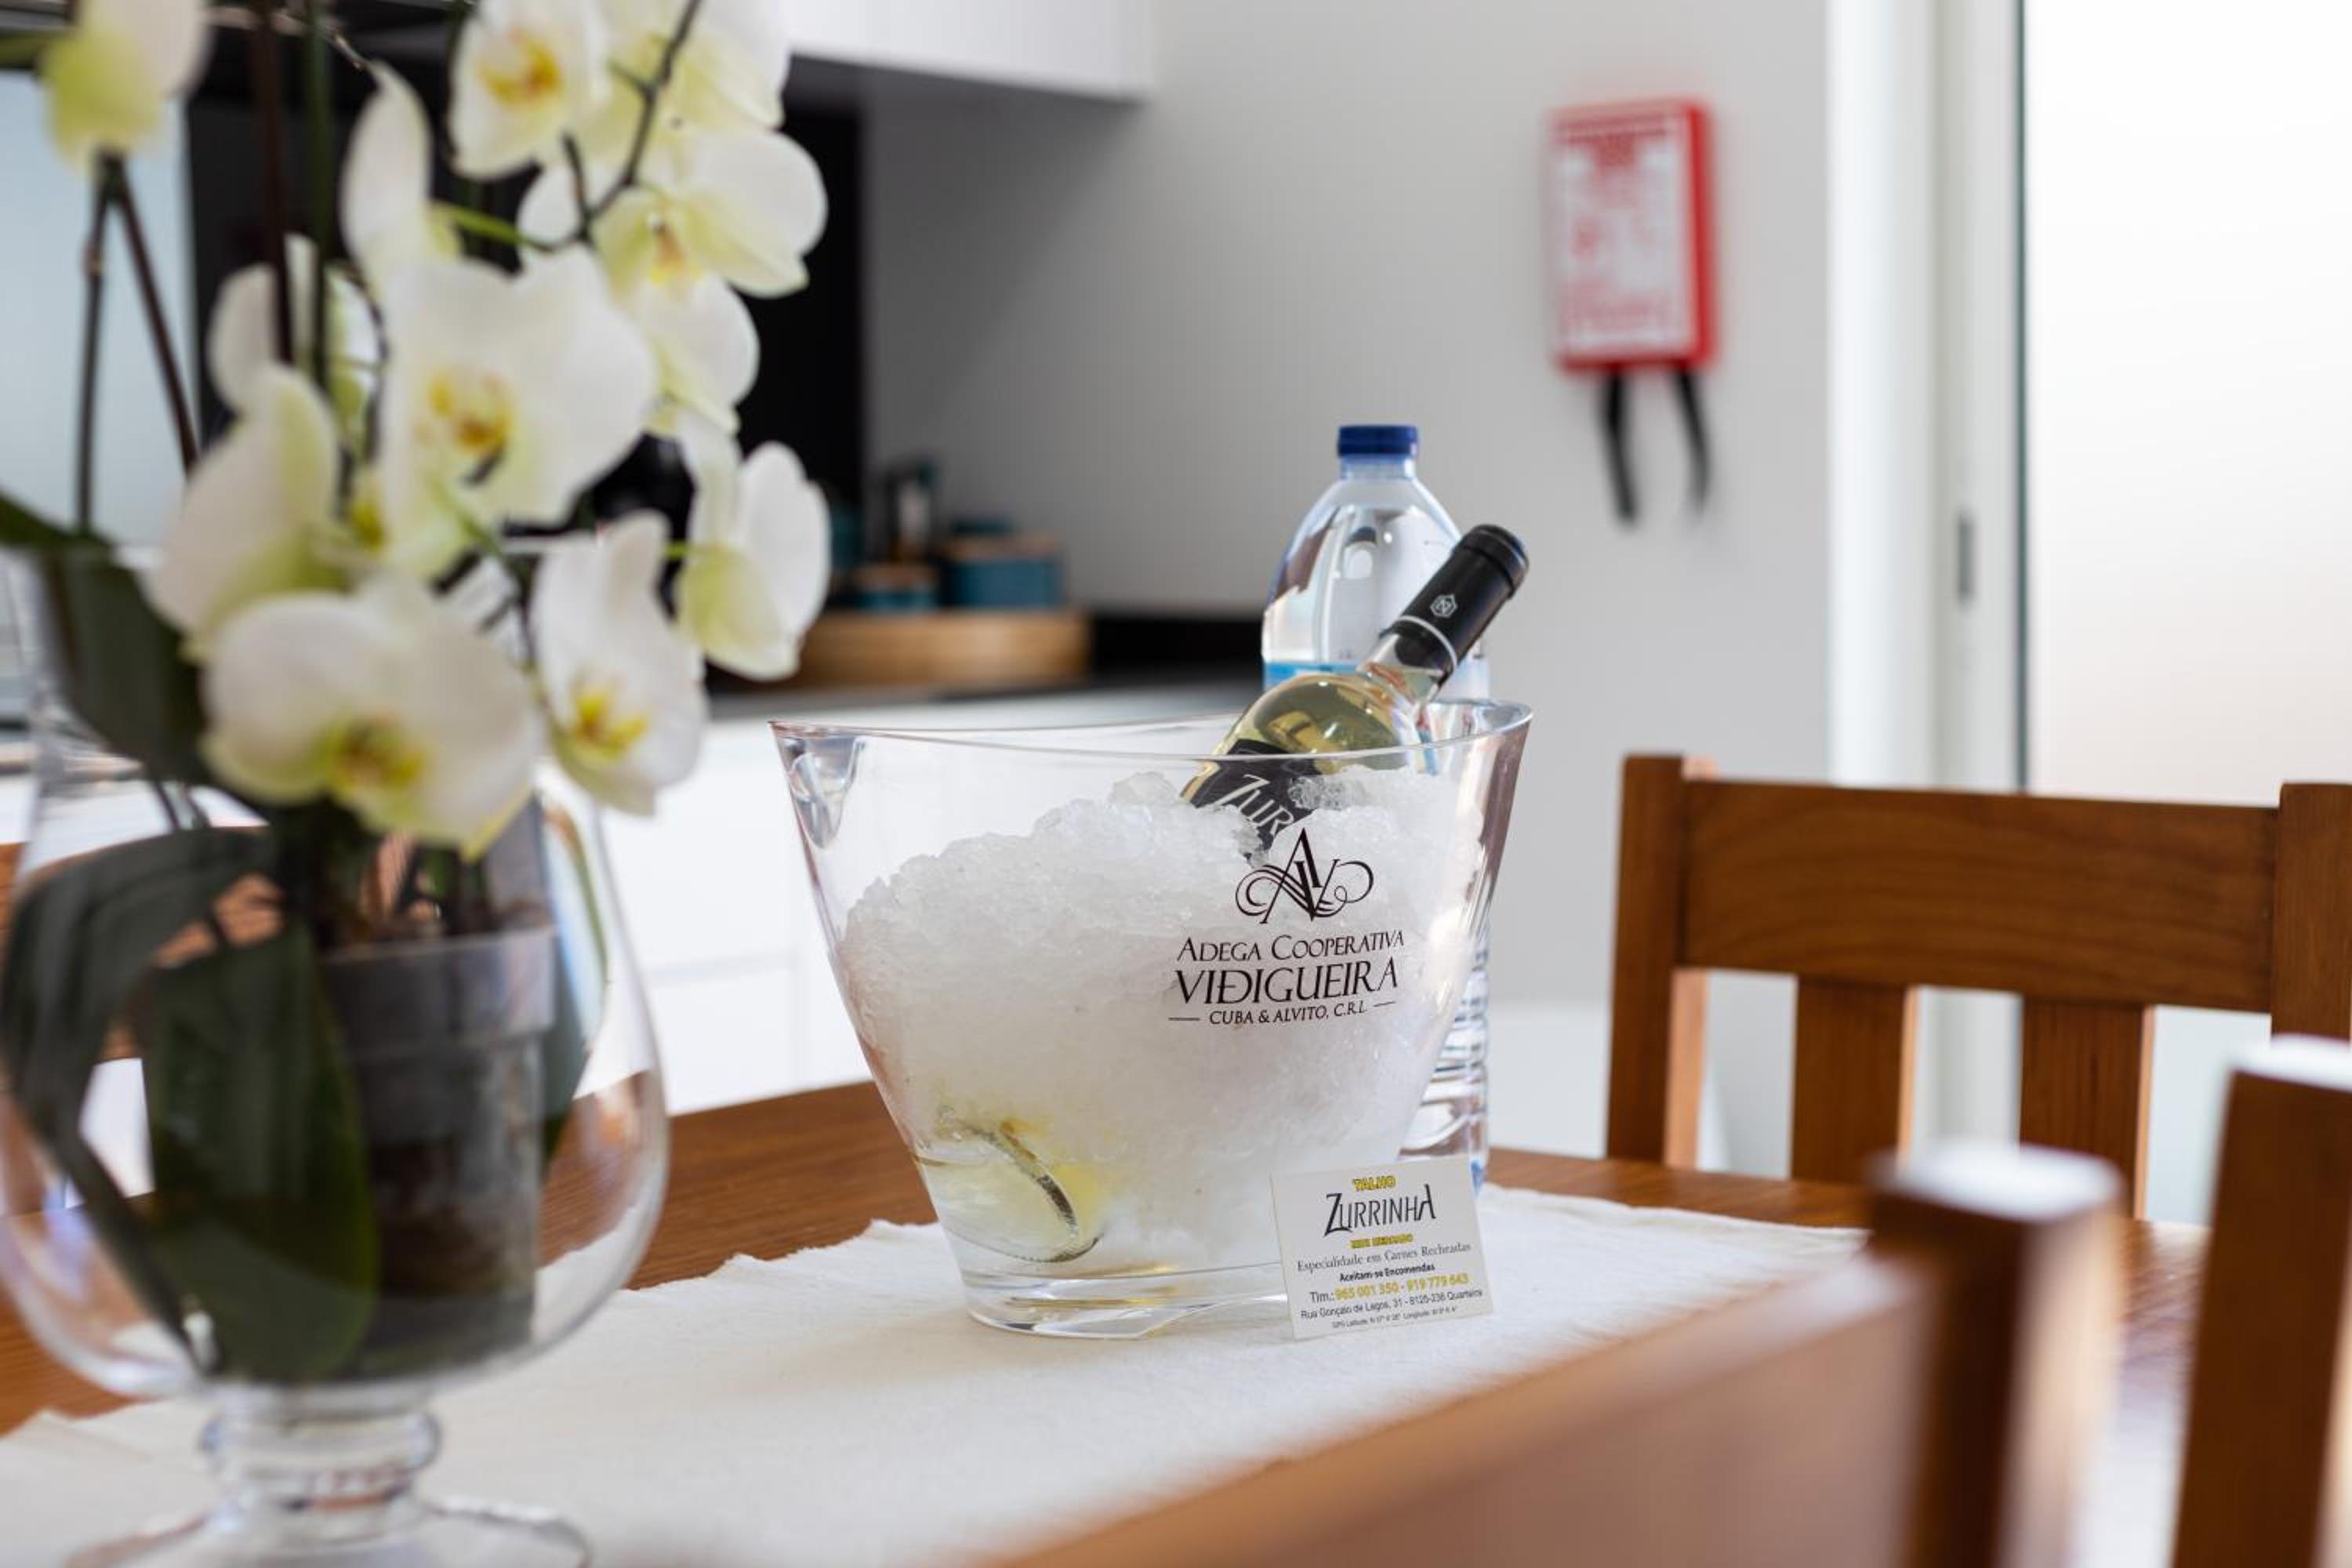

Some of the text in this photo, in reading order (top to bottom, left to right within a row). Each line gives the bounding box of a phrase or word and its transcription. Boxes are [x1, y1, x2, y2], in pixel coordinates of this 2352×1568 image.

[1177, 930, 1405, 962] ADEGA COOPERATIVA
[1175, 956, 1398, 1004] VIDIGUEIRA
[1210, 1011, 1254, 1025] CUBA
[1258, 1010, 1270, 1023] &
[1274, 1005, 1330, 1023] ALVITO,
[1352, 1175, 1396, 1191] TALHO
[1324, 1184, 1436, 1237] ZURRINHA
[1298, 1255, 1363, 1275] Especialidade
[1385, 1263, 1435, 1276] Encomendas
[1301, 1310, 1317, 1319] Rua
